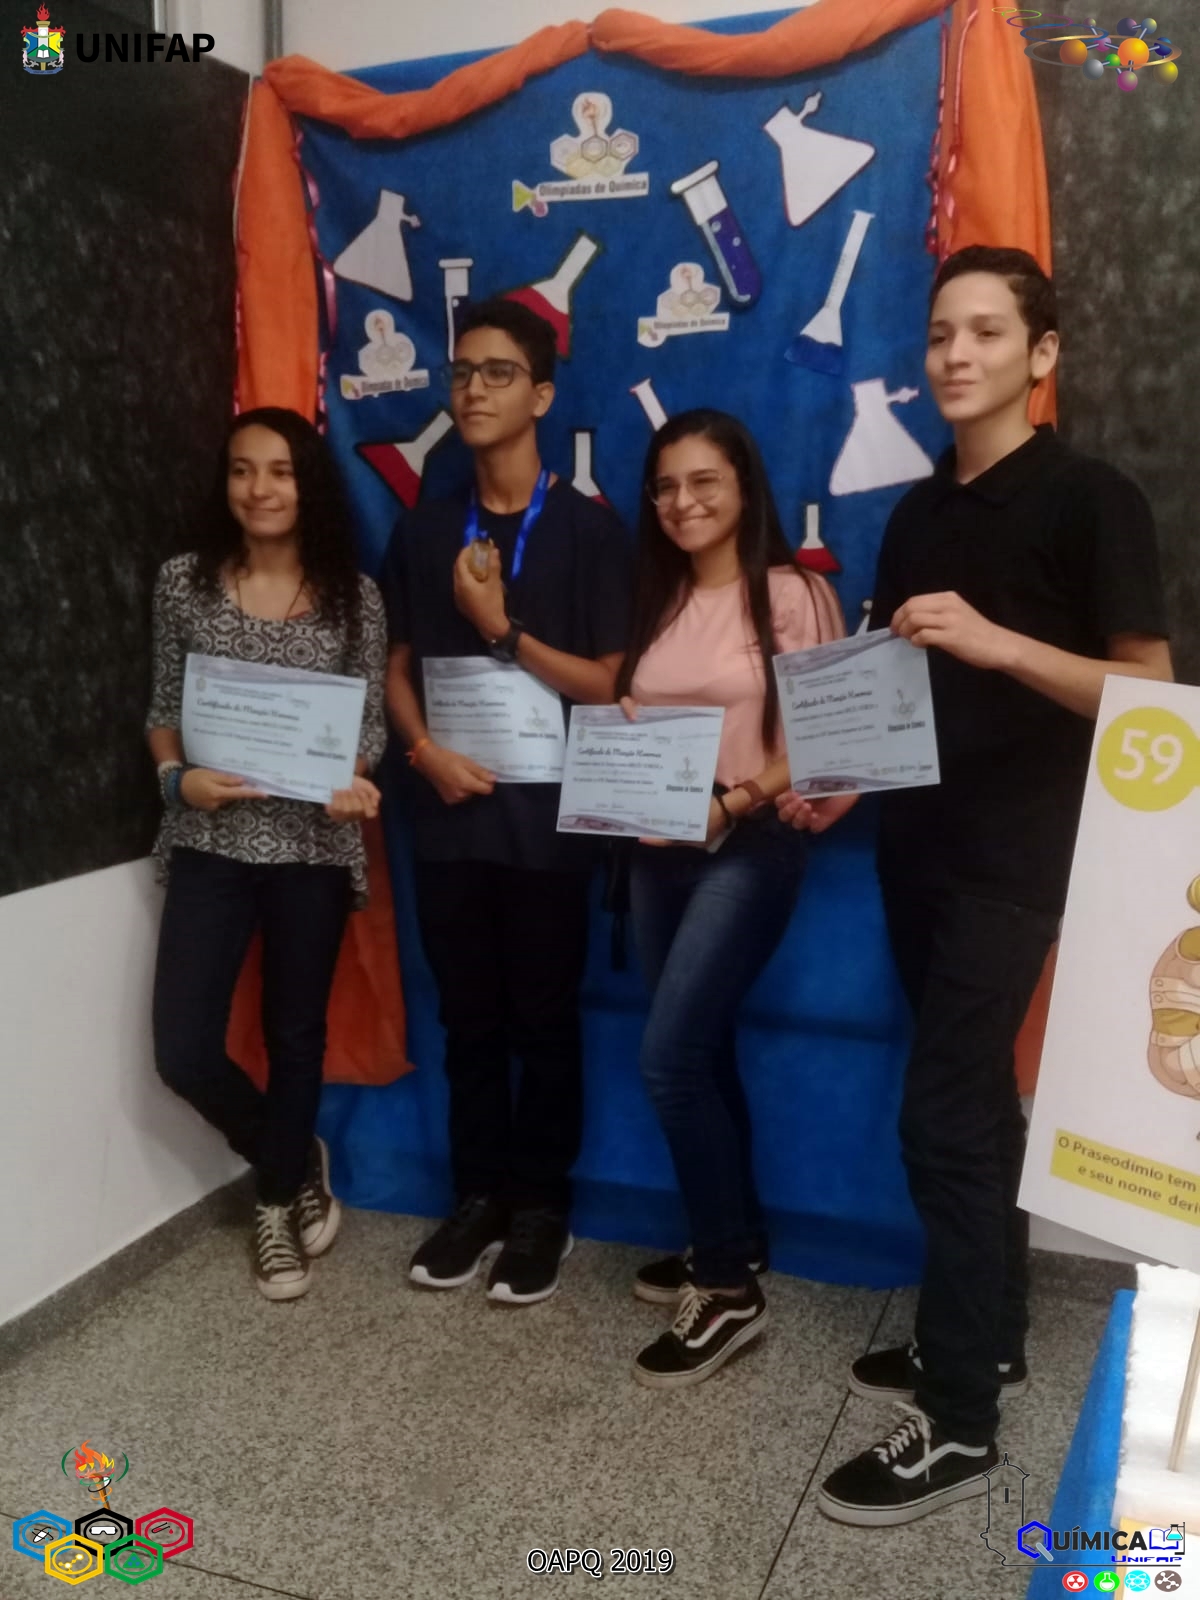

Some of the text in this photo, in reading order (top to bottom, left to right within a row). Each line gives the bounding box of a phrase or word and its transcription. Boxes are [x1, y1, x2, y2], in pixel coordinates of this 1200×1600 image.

[594, 182, 606, 194] de
[1113, 727, 1184, 785] 59
[1057, 1136, 1070, 1149] O
[1167, 1173, 1197, 1193] tem
[1077, 1165, 1087, 1176] e
[1089, 1168, 1114, 1186] seu
[1117, 1178, 1162, 1201] nome
